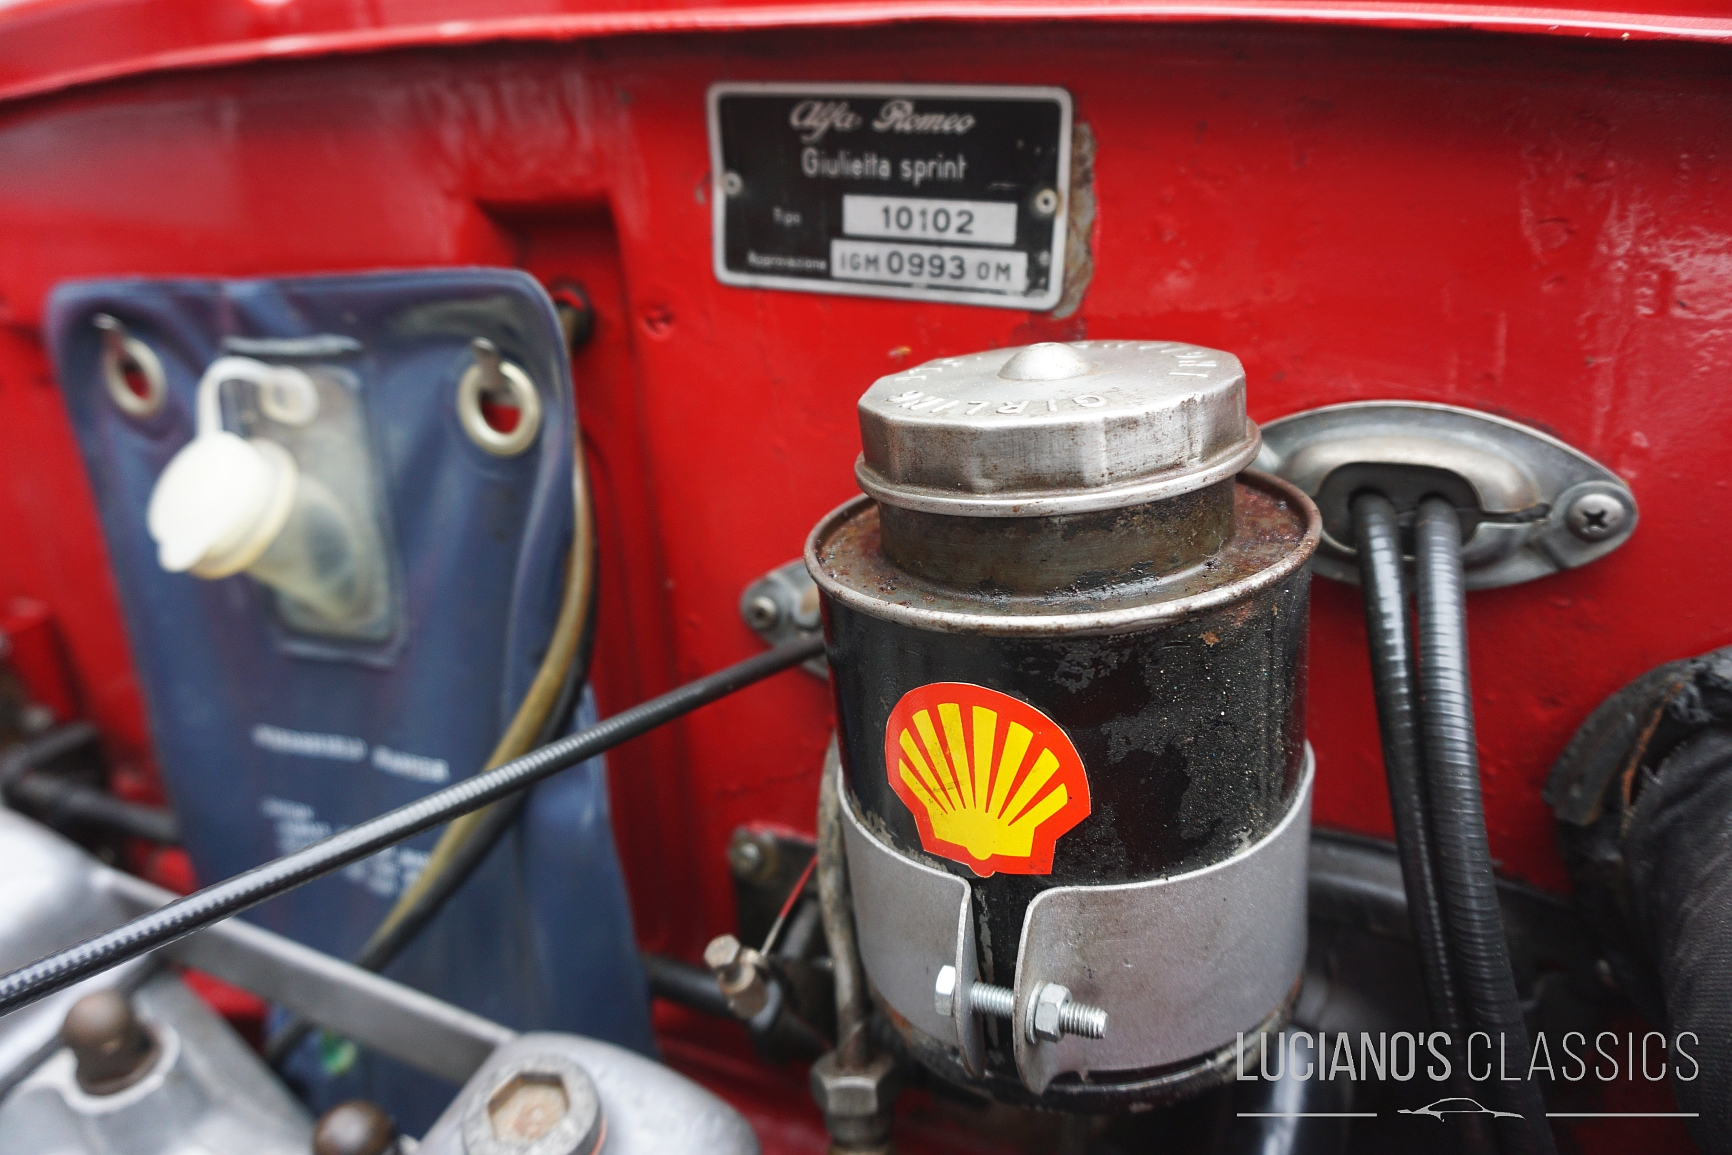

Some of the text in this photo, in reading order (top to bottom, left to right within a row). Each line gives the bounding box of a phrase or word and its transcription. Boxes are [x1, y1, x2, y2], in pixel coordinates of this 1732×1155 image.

[789, 100, 976, 141] Alfa Romeo
[802, 147, 967, 187] Giulietta sprint
[882, 206, 975, 230] 10102
[841, 252, 879, 271] IGM
[887, 251, 966, 279] 0993
